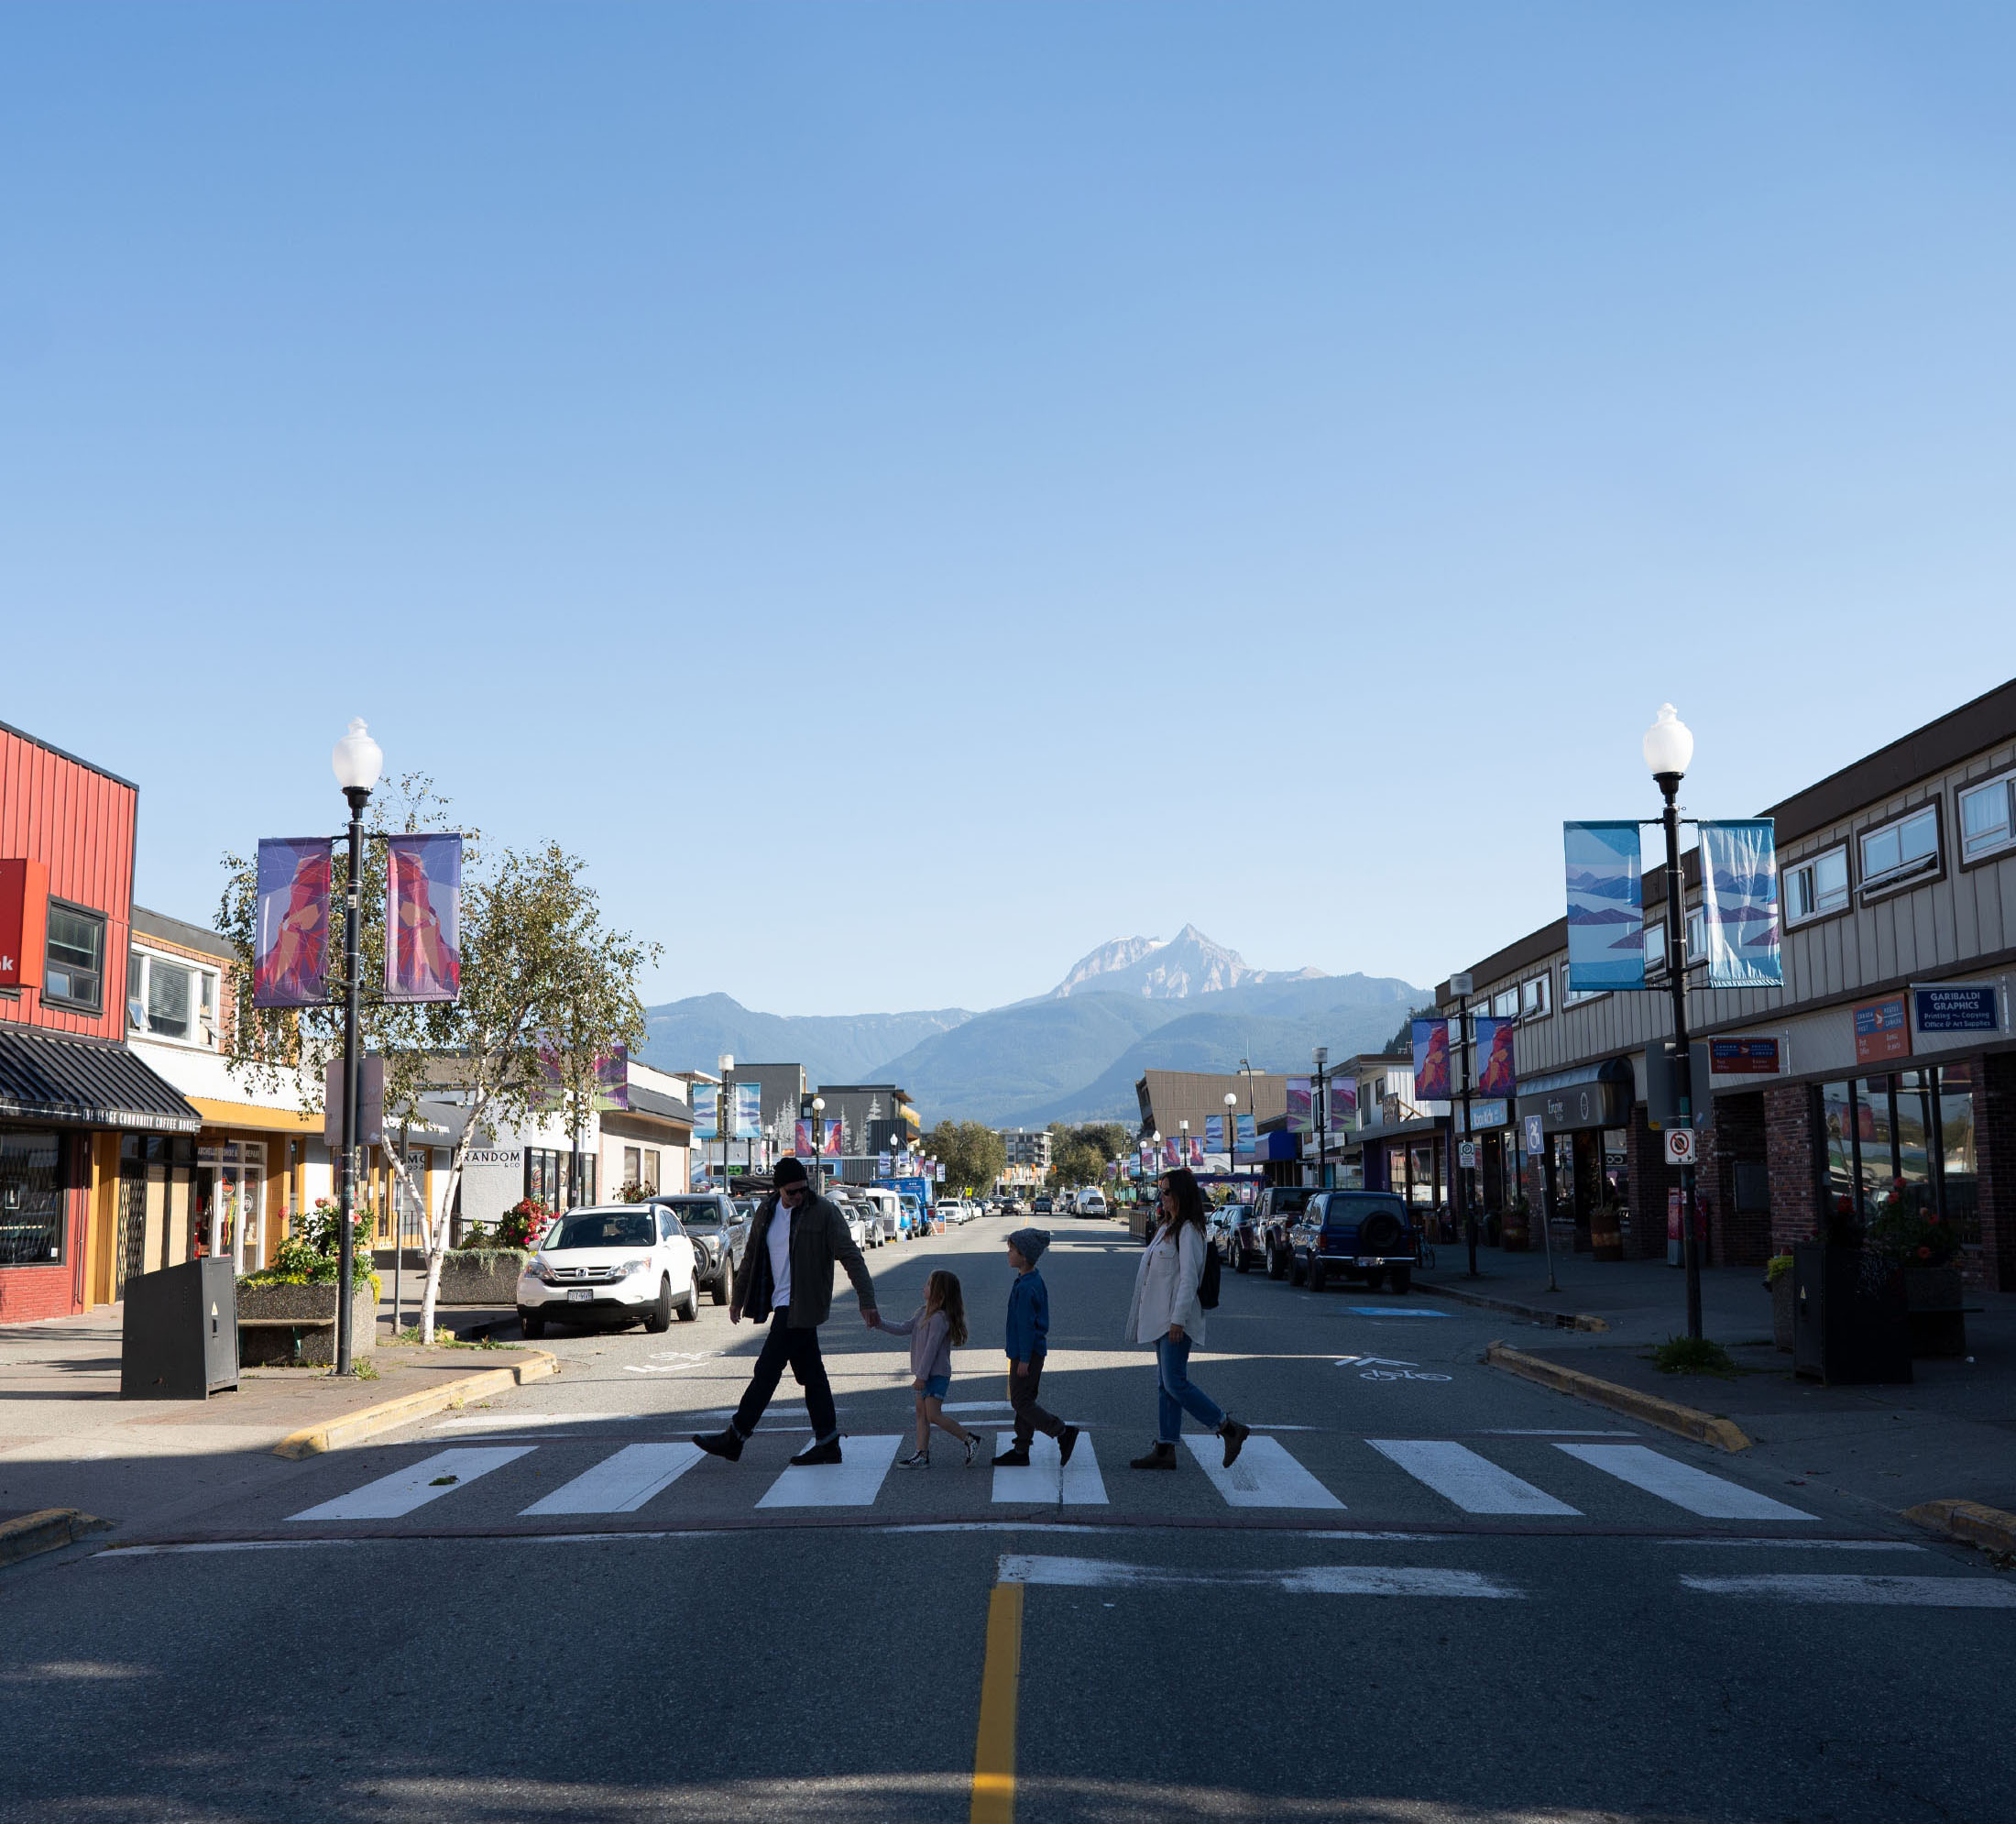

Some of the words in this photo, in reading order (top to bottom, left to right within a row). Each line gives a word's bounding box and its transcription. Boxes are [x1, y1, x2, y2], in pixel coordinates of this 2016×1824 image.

[0, 955, 14, 971] k
[1930, 992, 1980, 1001] GARIBALDI
[1934, 1002, 1979, 1010] GRAPHICS
[119, 1112, 153, 1127] COMMUNITY
[155, 1116, 177, 1129] COFFEE
[464, 1152, 520, 1161] RANDOM
